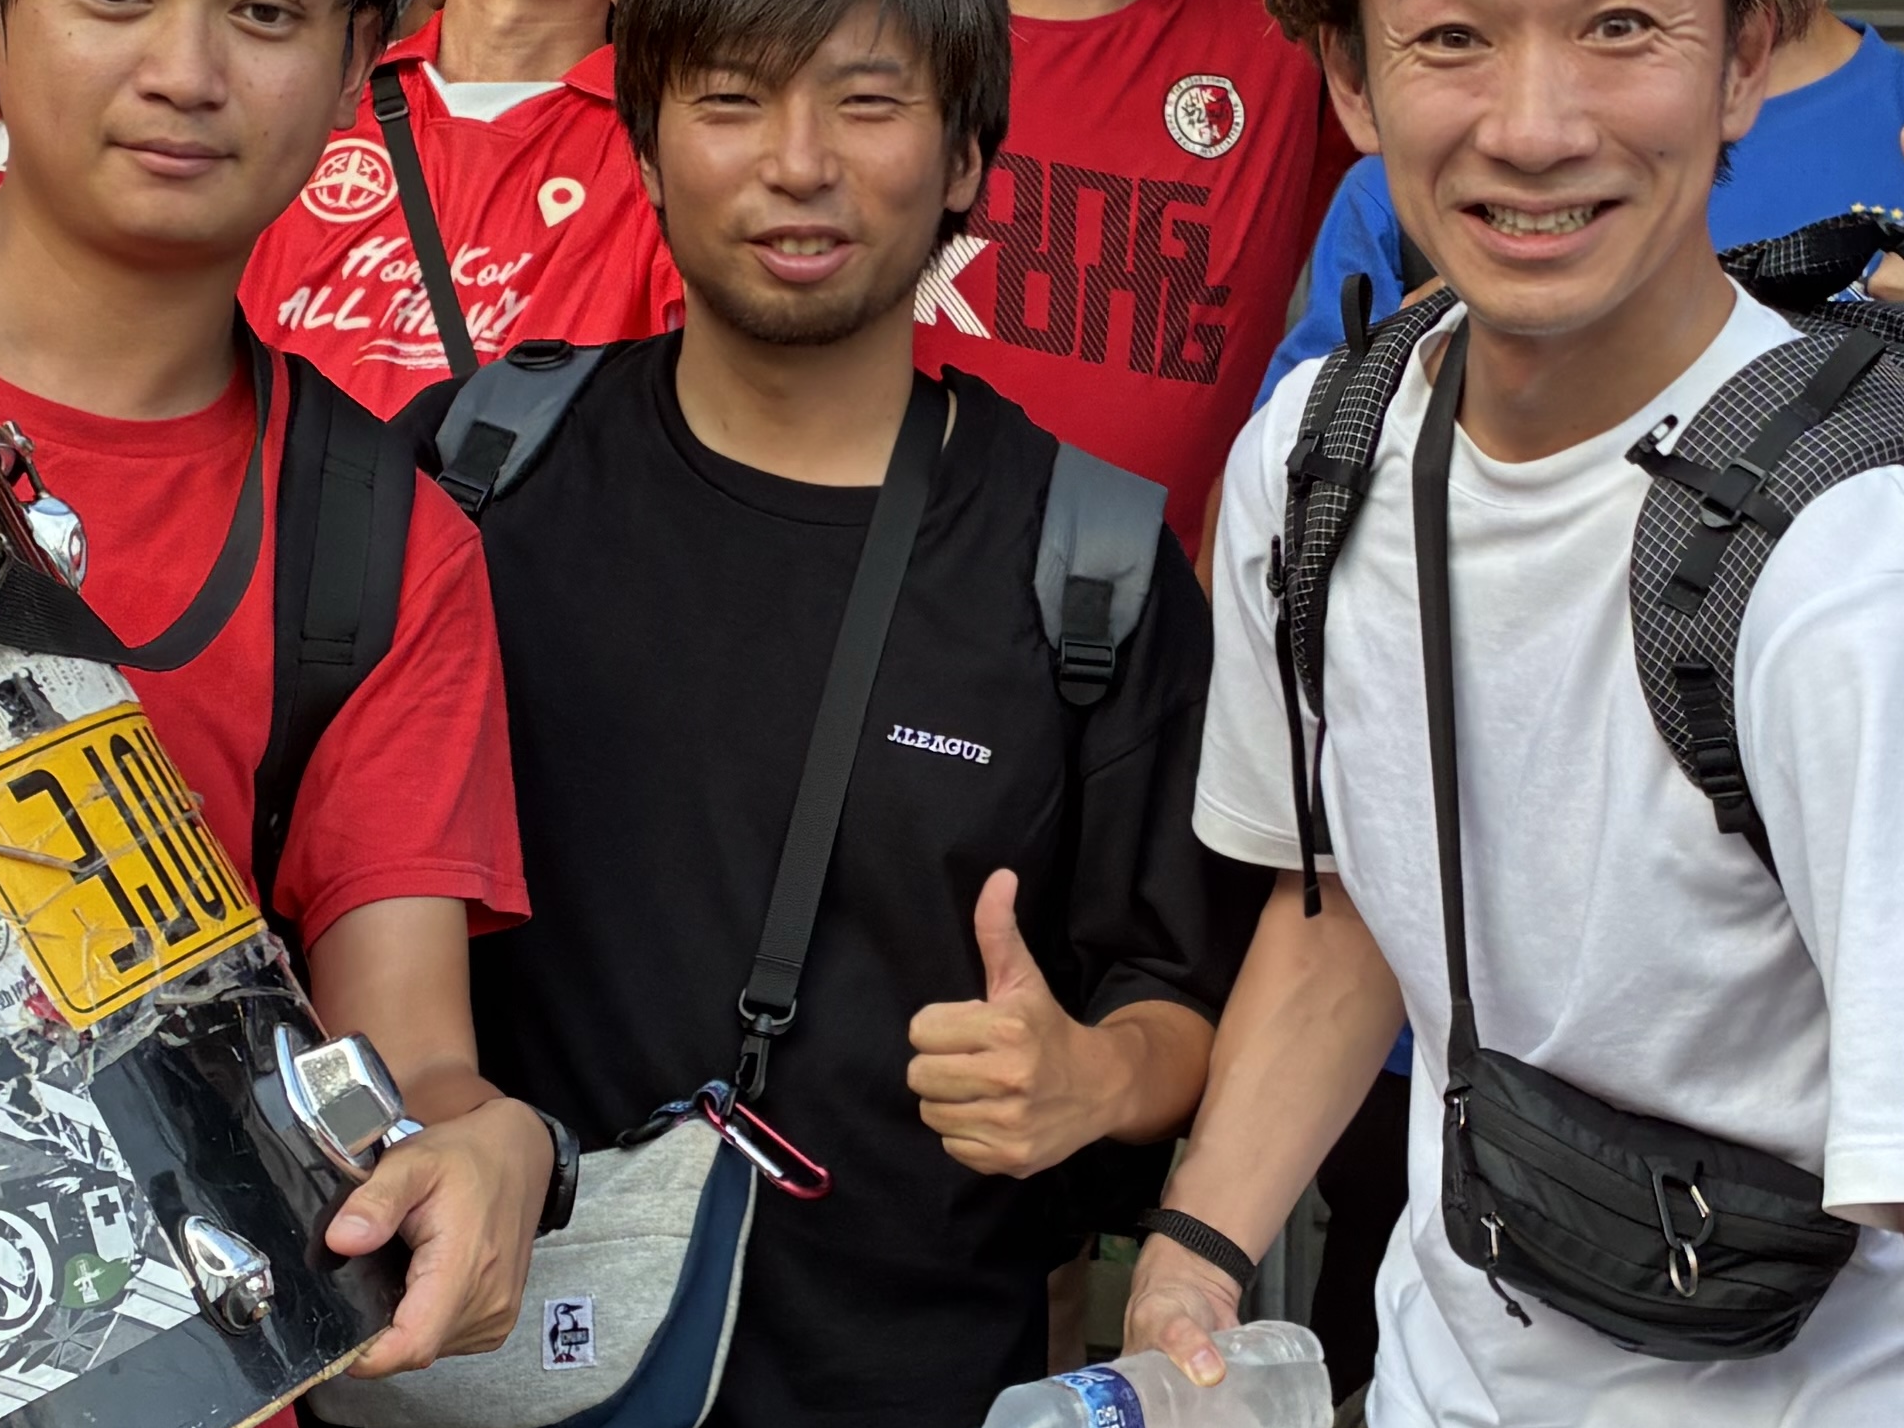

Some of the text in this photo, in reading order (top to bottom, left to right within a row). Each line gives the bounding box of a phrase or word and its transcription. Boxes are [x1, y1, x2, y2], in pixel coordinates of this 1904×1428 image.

[968, 152, 1211, 287] ONG
[277, 286, 373, 331] ALL
[887, 723, 992, 765] J.LEAGUE
